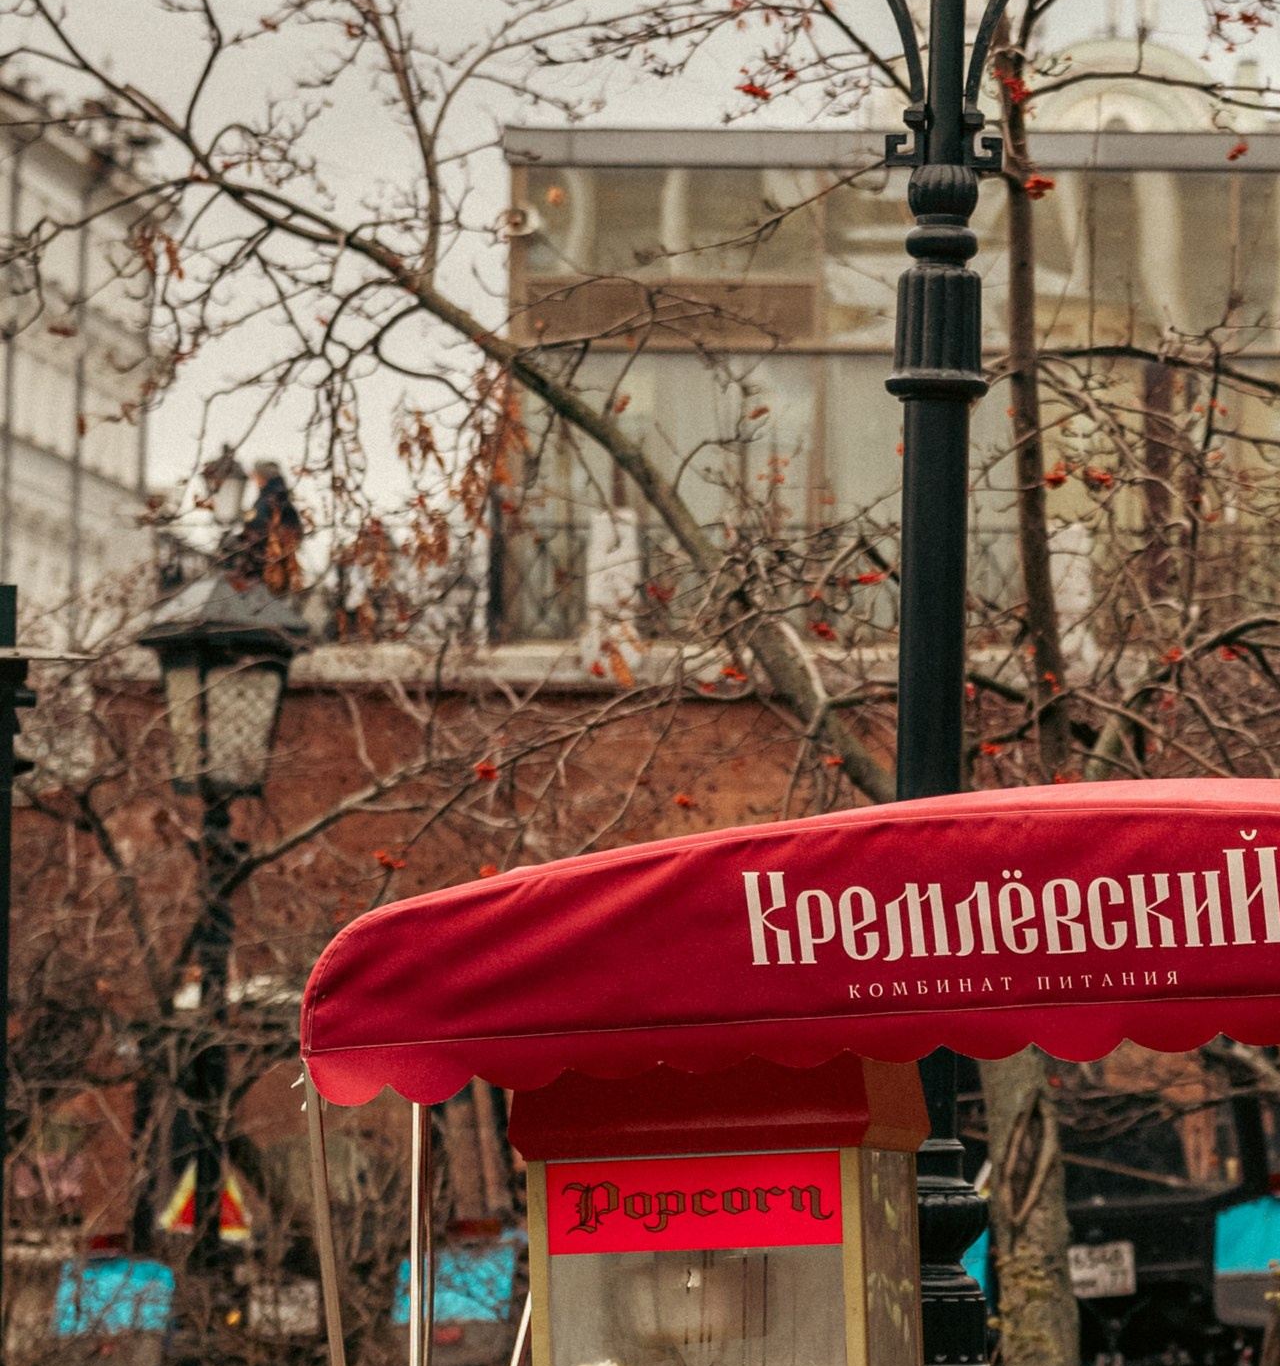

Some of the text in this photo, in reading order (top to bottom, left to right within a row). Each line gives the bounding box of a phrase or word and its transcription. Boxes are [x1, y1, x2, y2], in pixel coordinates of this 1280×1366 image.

[849, 970, 1179, 999] КОМБИНАТ ПИТАНИЯ
[561, 1180, 834, 1235] Popcorn
